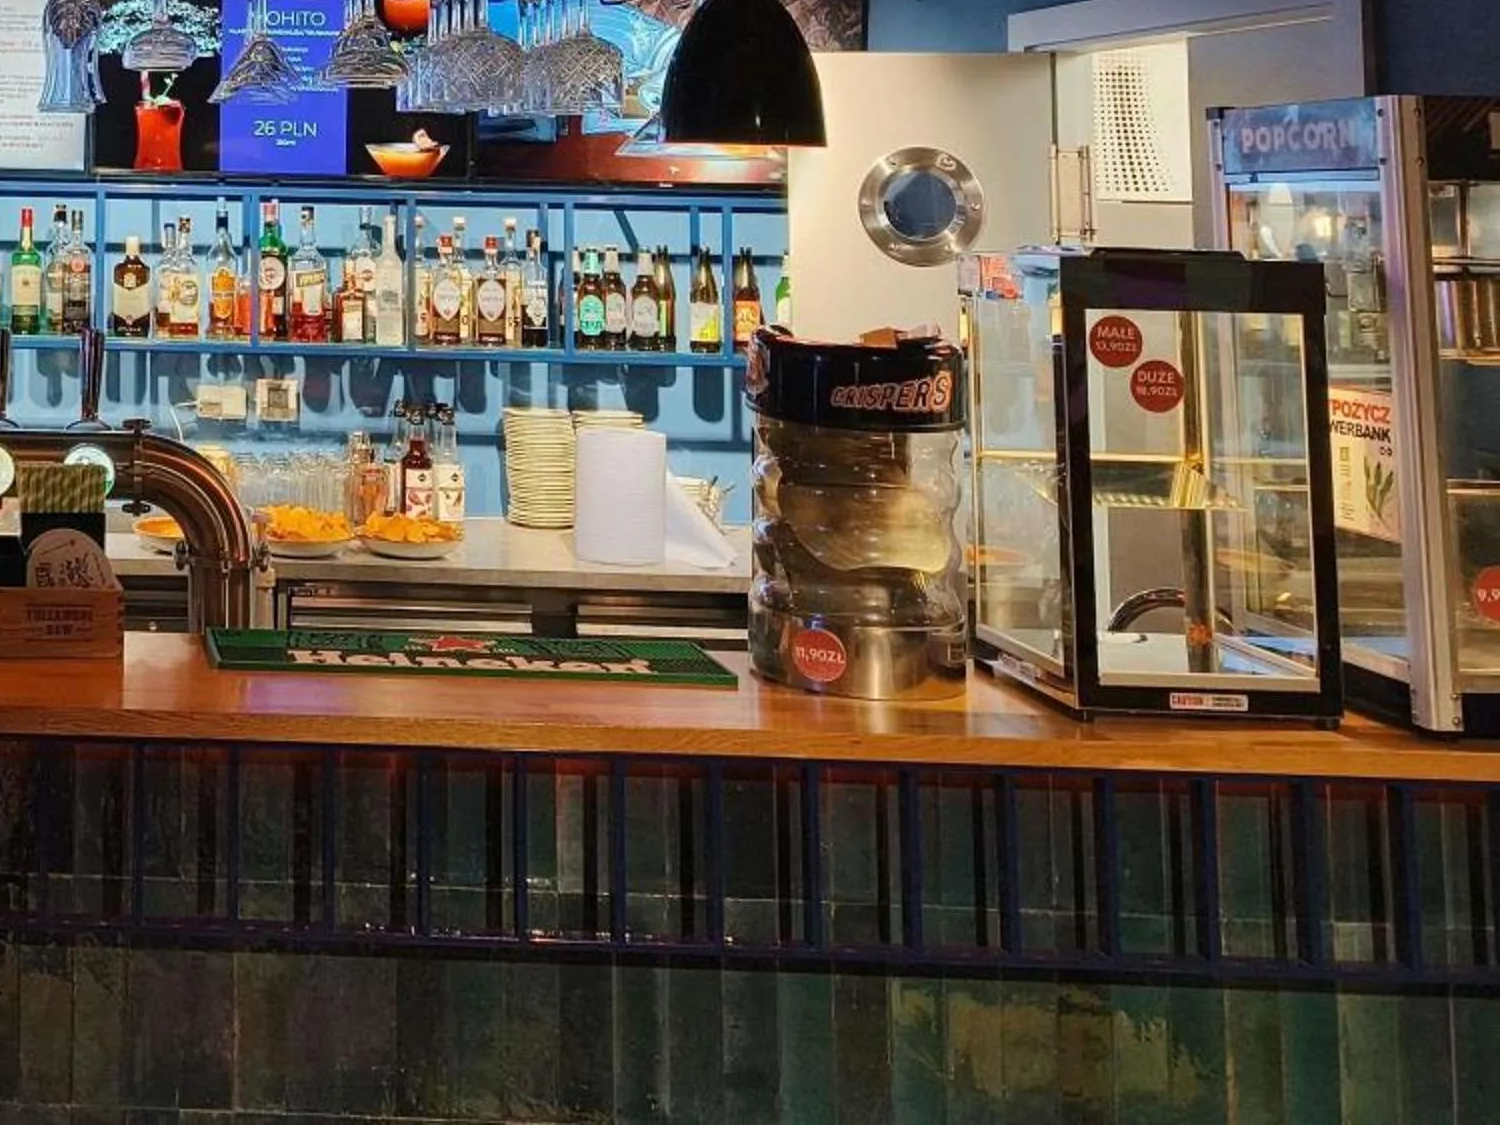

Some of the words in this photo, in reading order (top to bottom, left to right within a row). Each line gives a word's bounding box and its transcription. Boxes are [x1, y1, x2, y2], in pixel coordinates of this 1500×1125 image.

[254, 120, 276, 136] 26
[280, 121, 318, 137] PLN
[1241, 118, 1357, 154] POPCORN
[830, 371, 953, 411] CRISPERS
[1328, 398, 1391, 424] POŻYCZ
[287, 649, 657, 674] Heineken
